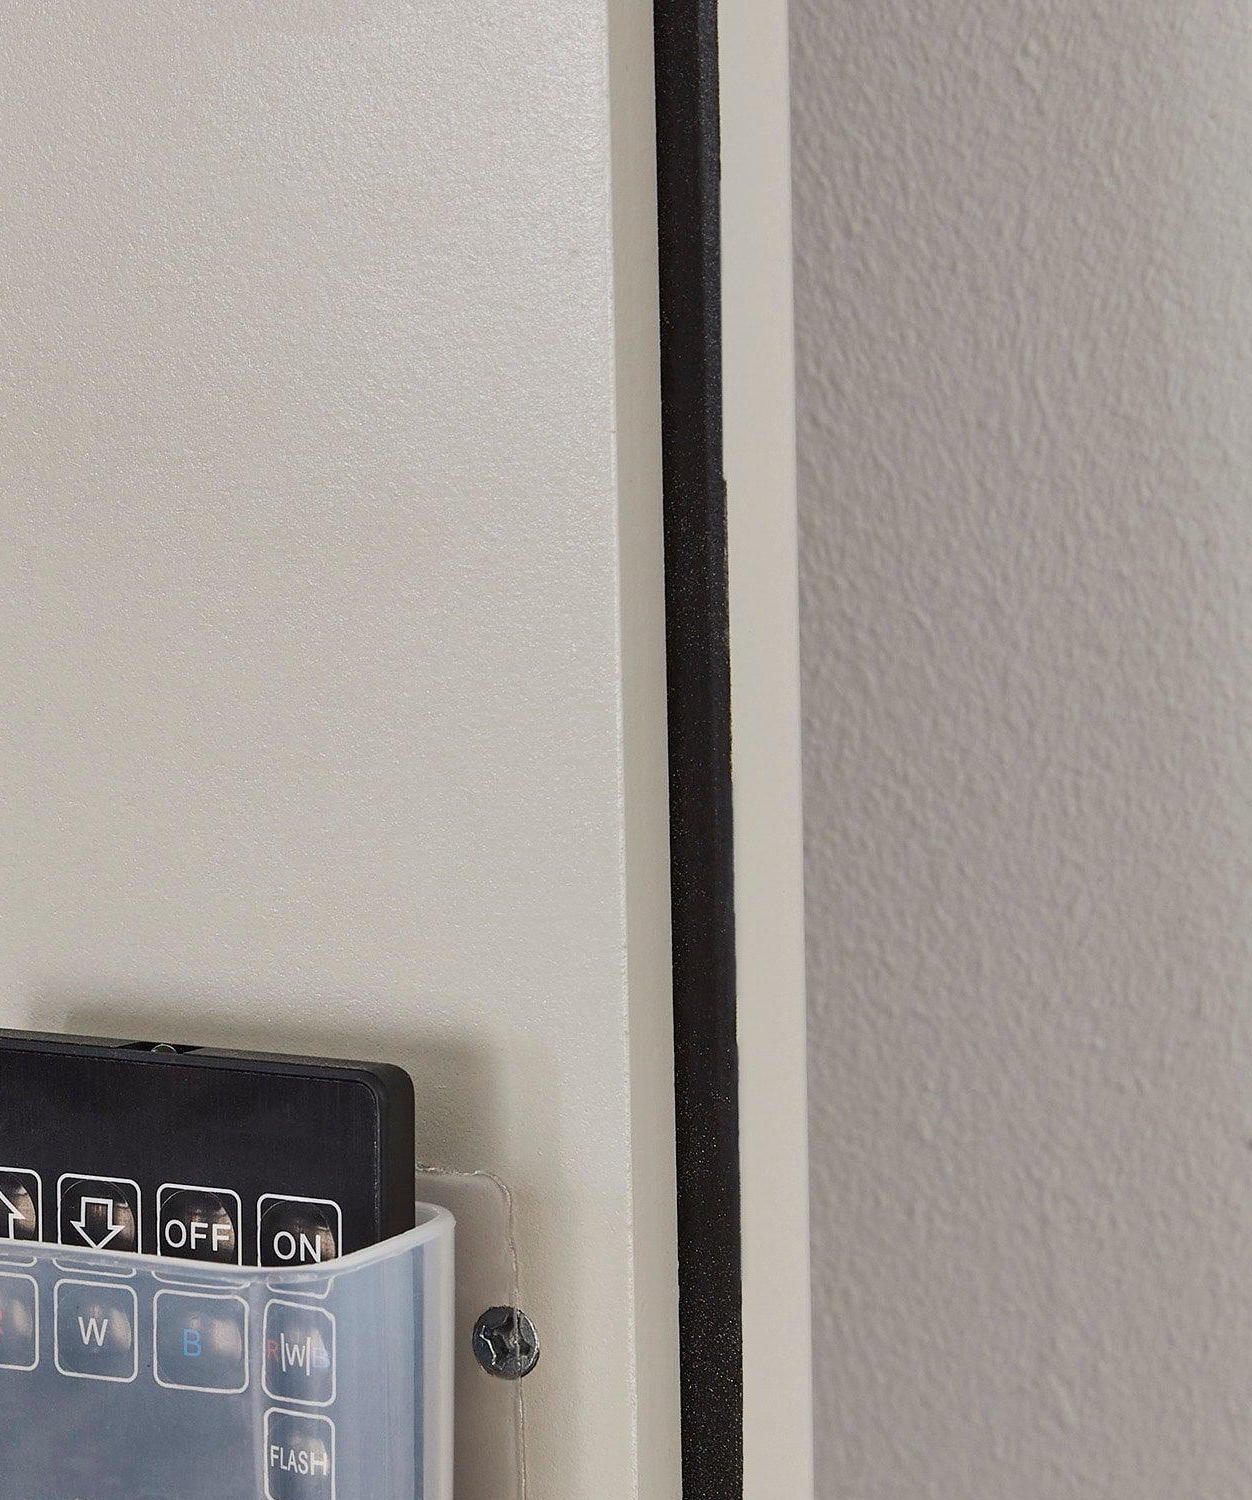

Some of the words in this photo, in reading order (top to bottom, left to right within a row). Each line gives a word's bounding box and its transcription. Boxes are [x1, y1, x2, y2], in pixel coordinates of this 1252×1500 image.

[165, 1219, 231, 1252] OFF
[273, 1231, 321, 1263] ON
[78, 1316, 108, 1347] W
[183, 1328, 202, 1357] B
[270, 1445, 327, 1476] FLASH
